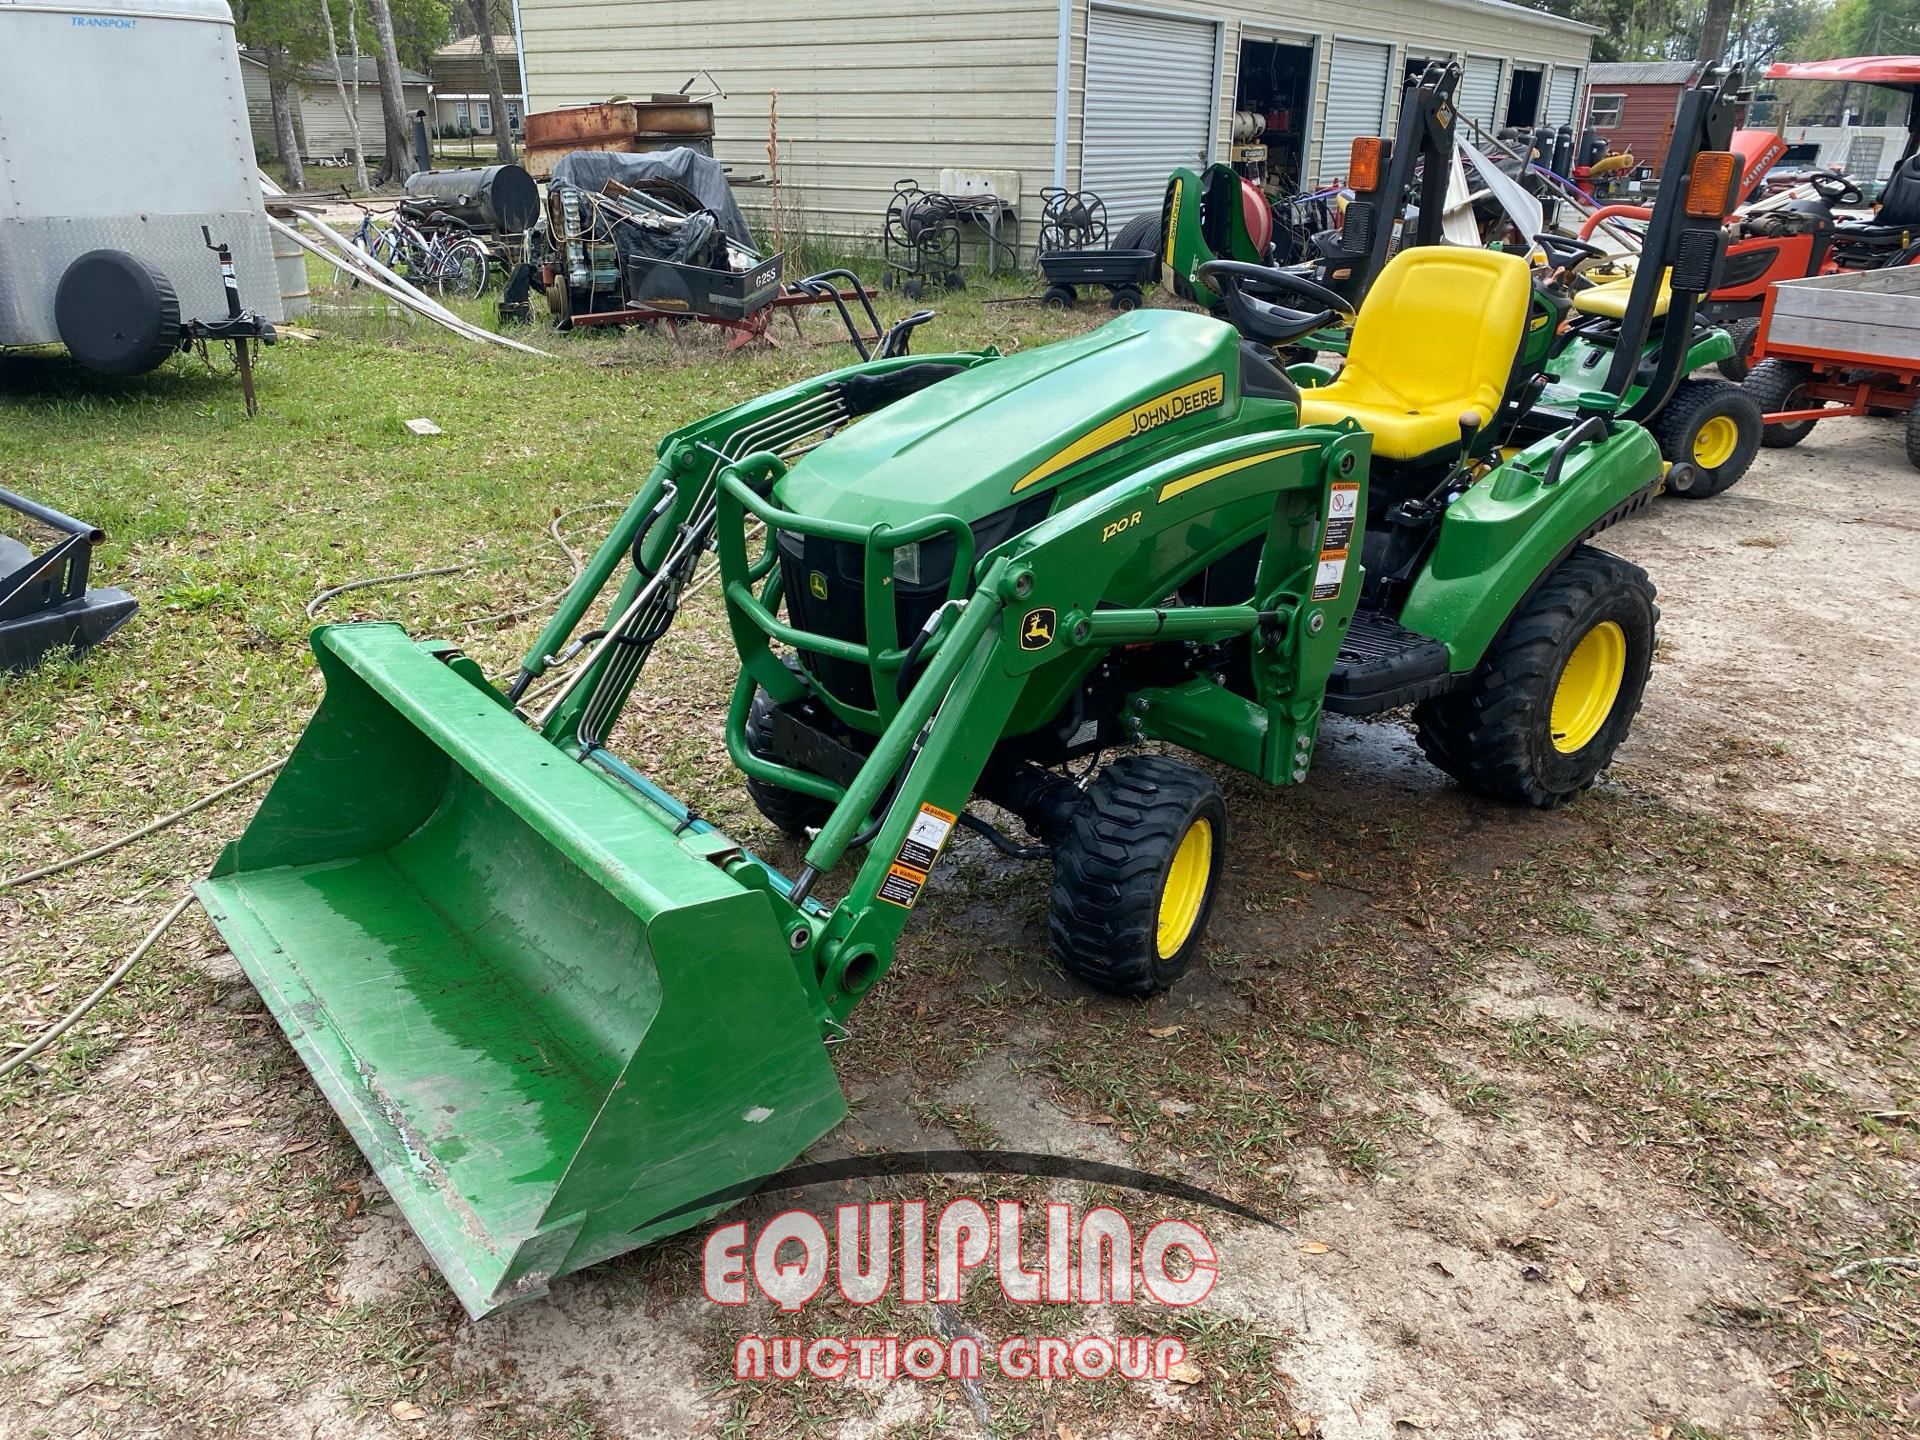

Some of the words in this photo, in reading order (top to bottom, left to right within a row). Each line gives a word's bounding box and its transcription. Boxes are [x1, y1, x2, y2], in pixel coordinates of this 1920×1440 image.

[71, 16, 137, 29] TRANSPORT
[1743, 145, 1781, 187] KUBOTA
[1173, 192, 1182, 219] DEERE
[1170, 219, 1178, 240] JOHN
[1129, 403, 1171, 435] JOHN
[1171, 387, 1219, 416] DEERE
[930, 808, 952, 821] WARNING
[899, 868, 922, 882] WARNING
